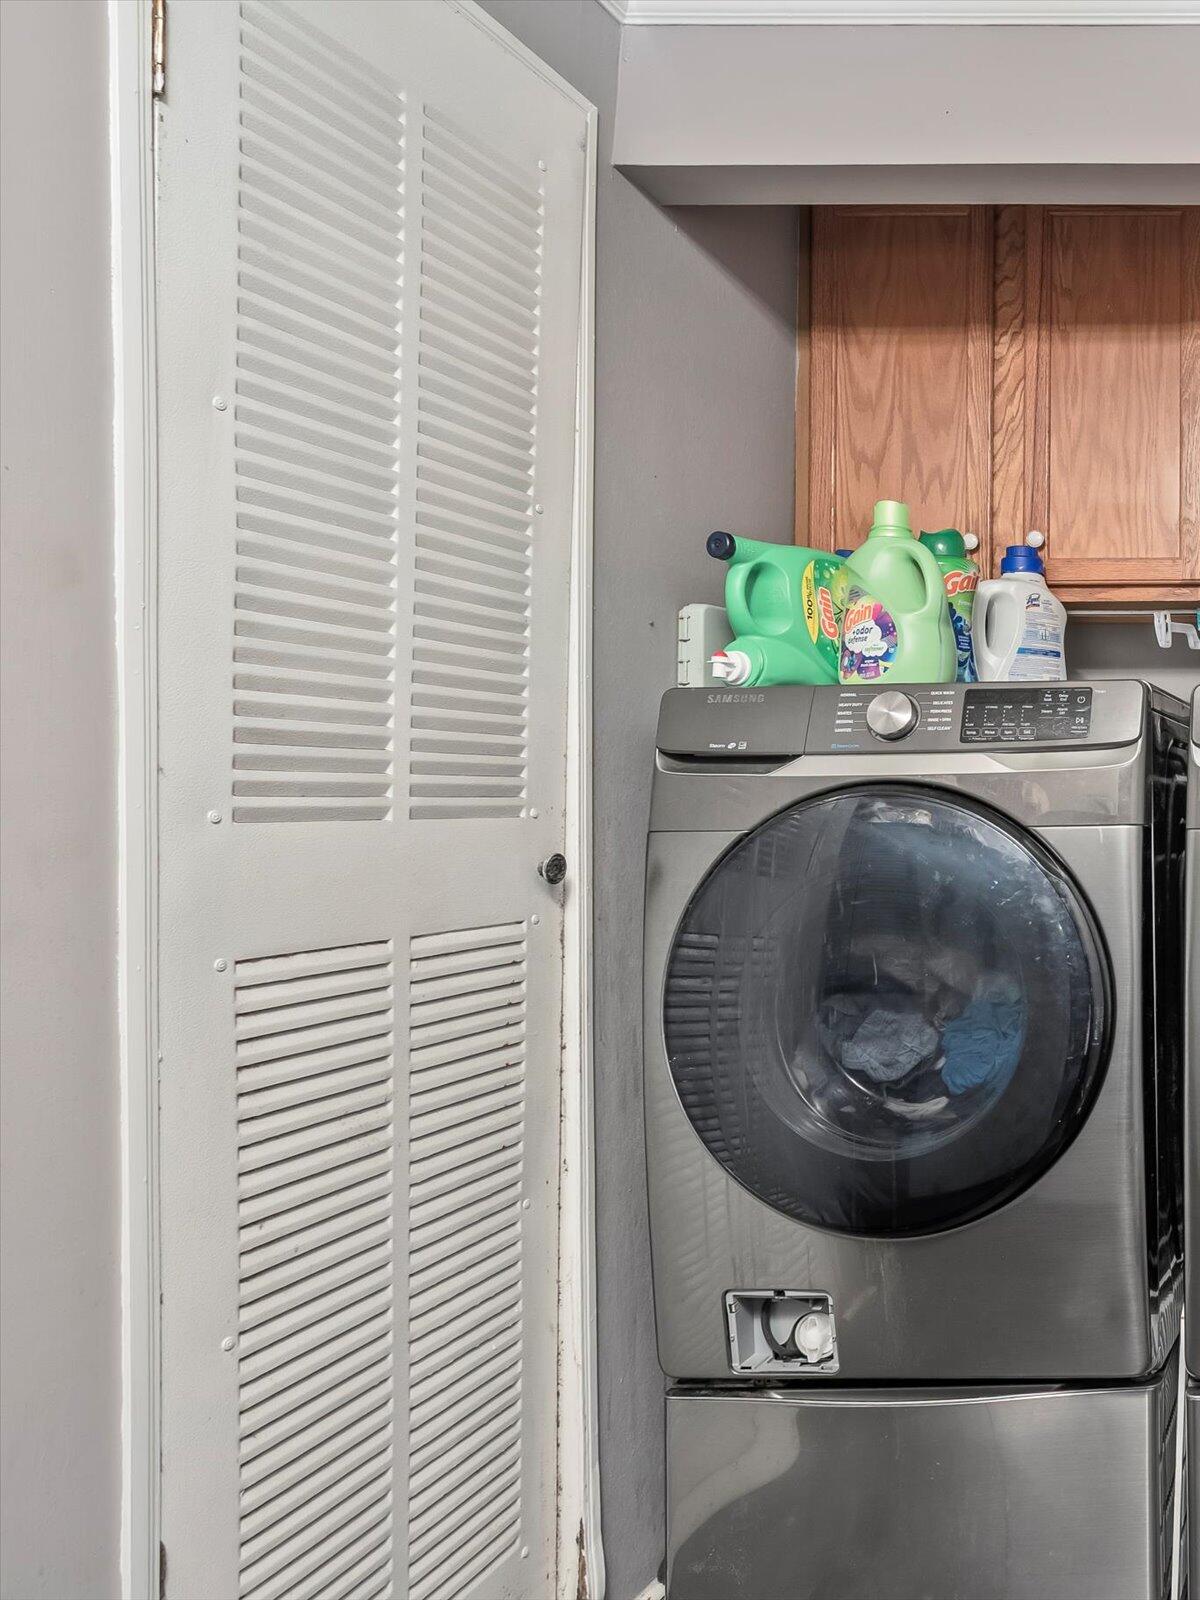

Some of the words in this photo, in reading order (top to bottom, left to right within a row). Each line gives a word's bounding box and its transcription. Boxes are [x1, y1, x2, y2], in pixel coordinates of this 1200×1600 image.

[818, 586, 839, 640] Gain
[844, 604, 874, 634] Gain
[707, 693, 765, 703] SAMSUNG
